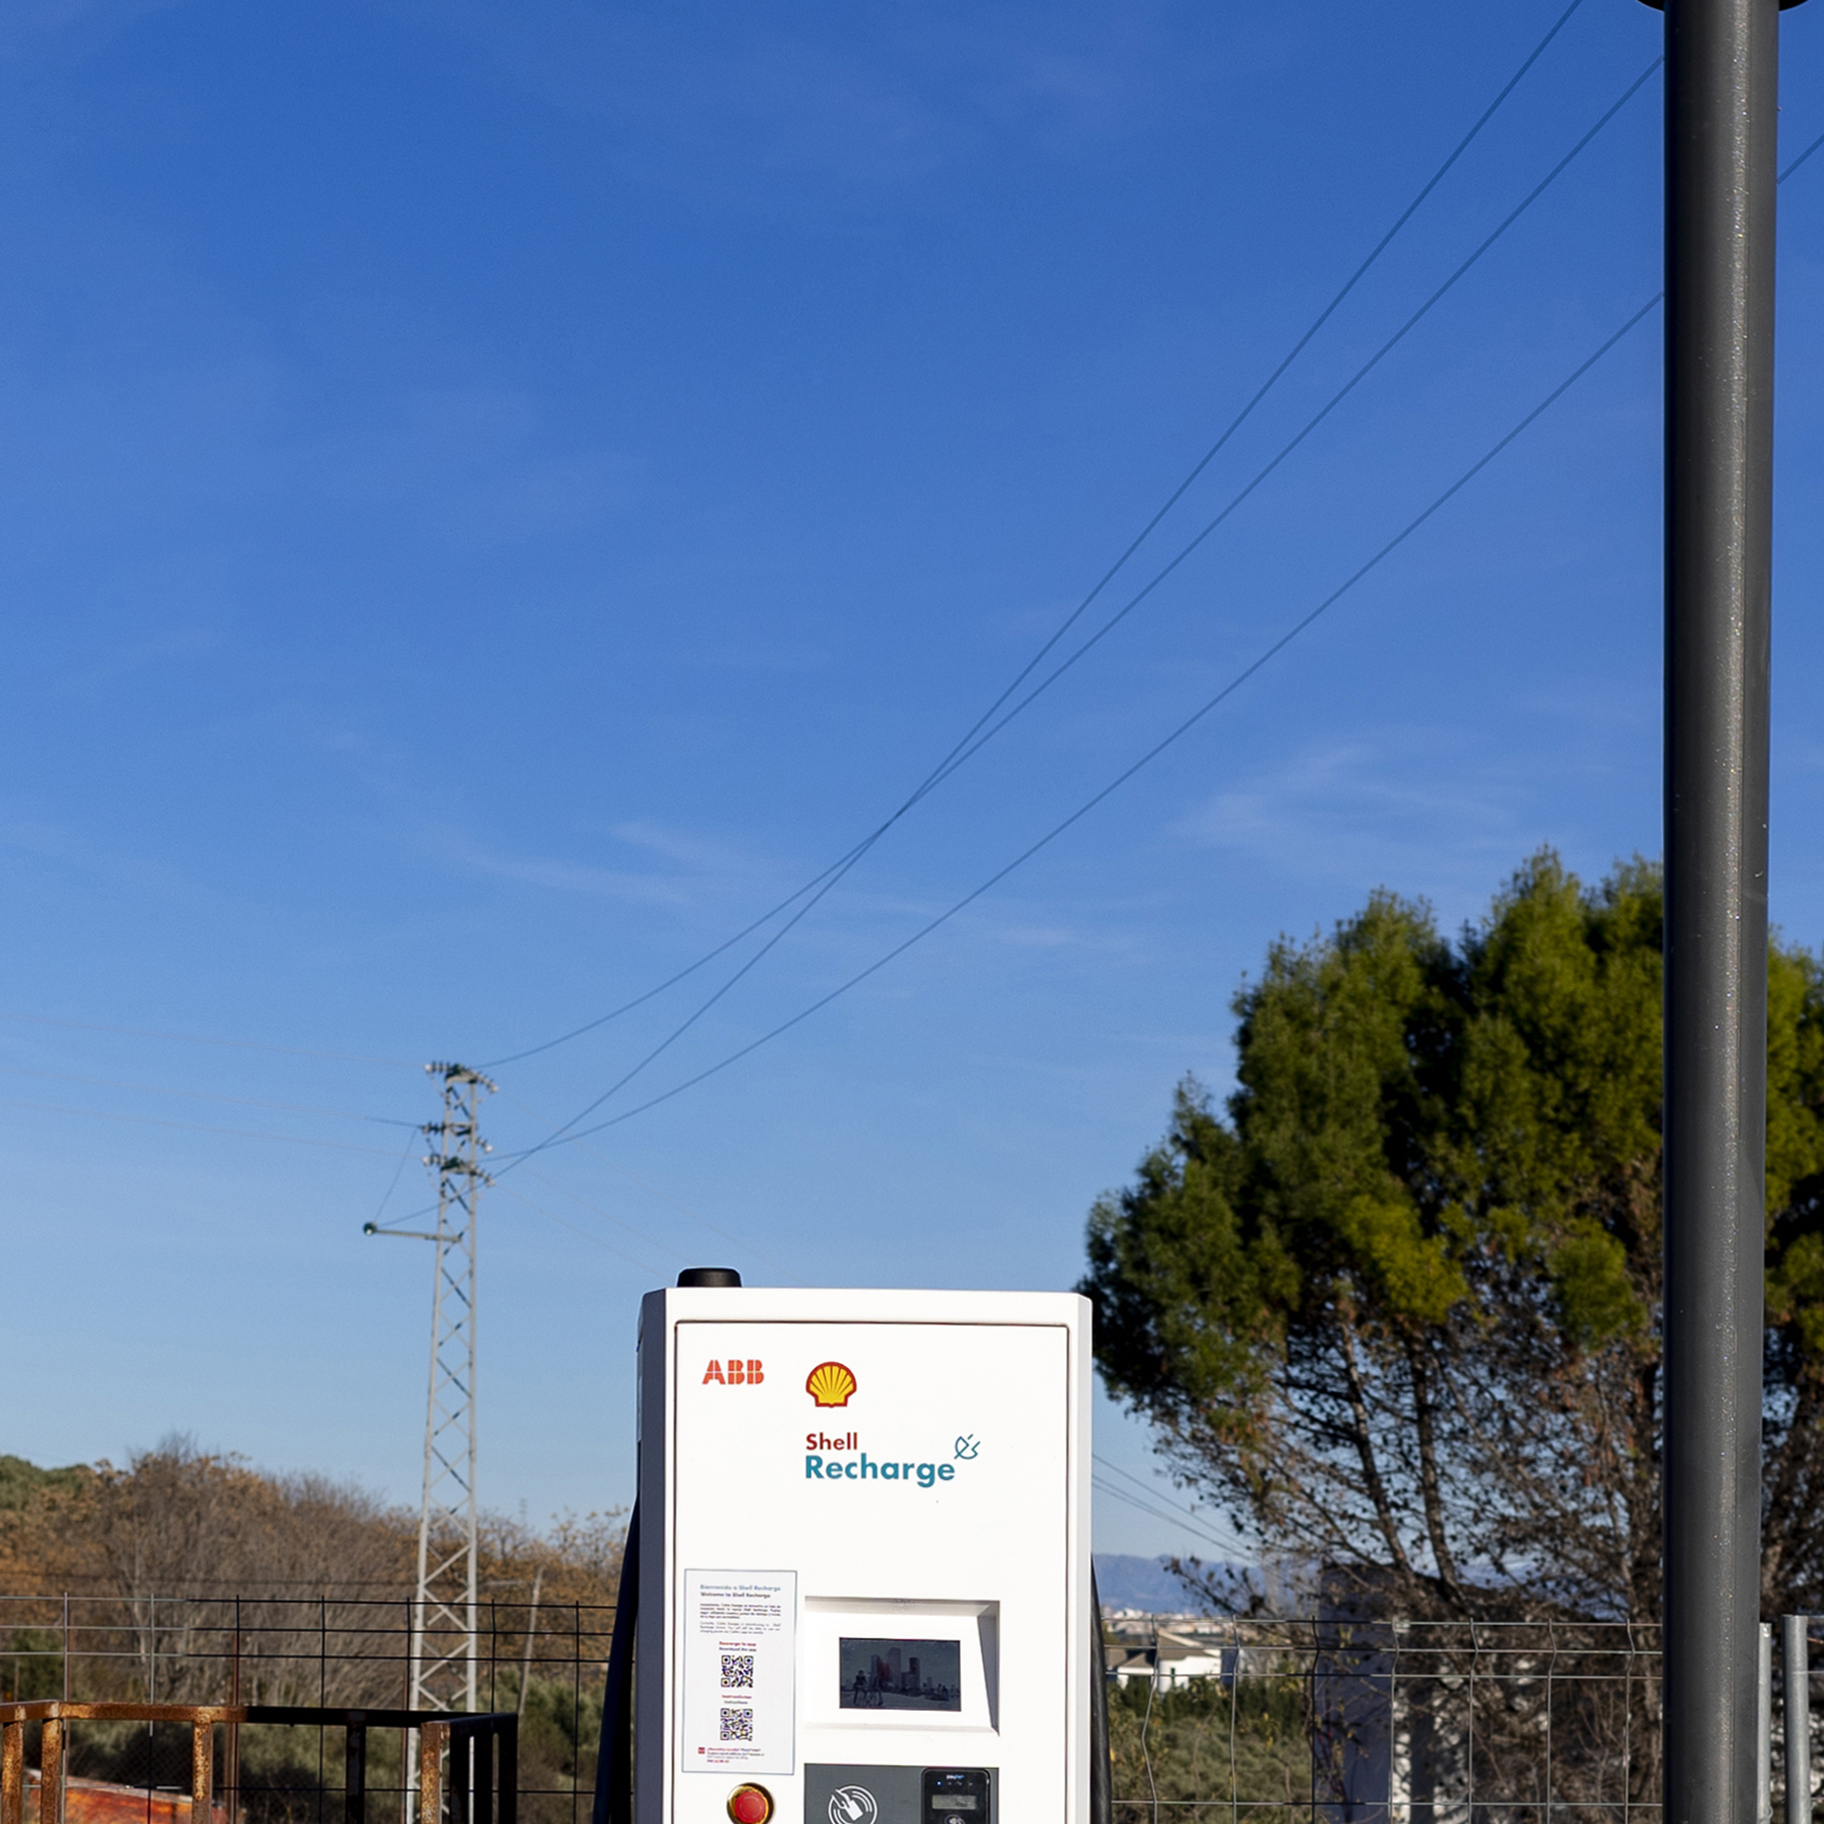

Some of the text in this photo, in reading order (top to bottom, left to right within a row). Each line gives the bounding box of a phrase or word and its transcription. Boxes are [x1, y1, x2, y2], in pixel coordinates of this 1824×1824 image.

[702, 1360, 765, 1385] ABB
[806, 1432, 858, 1450] Shell
[805, 1453, 955, 1488] Recharge
